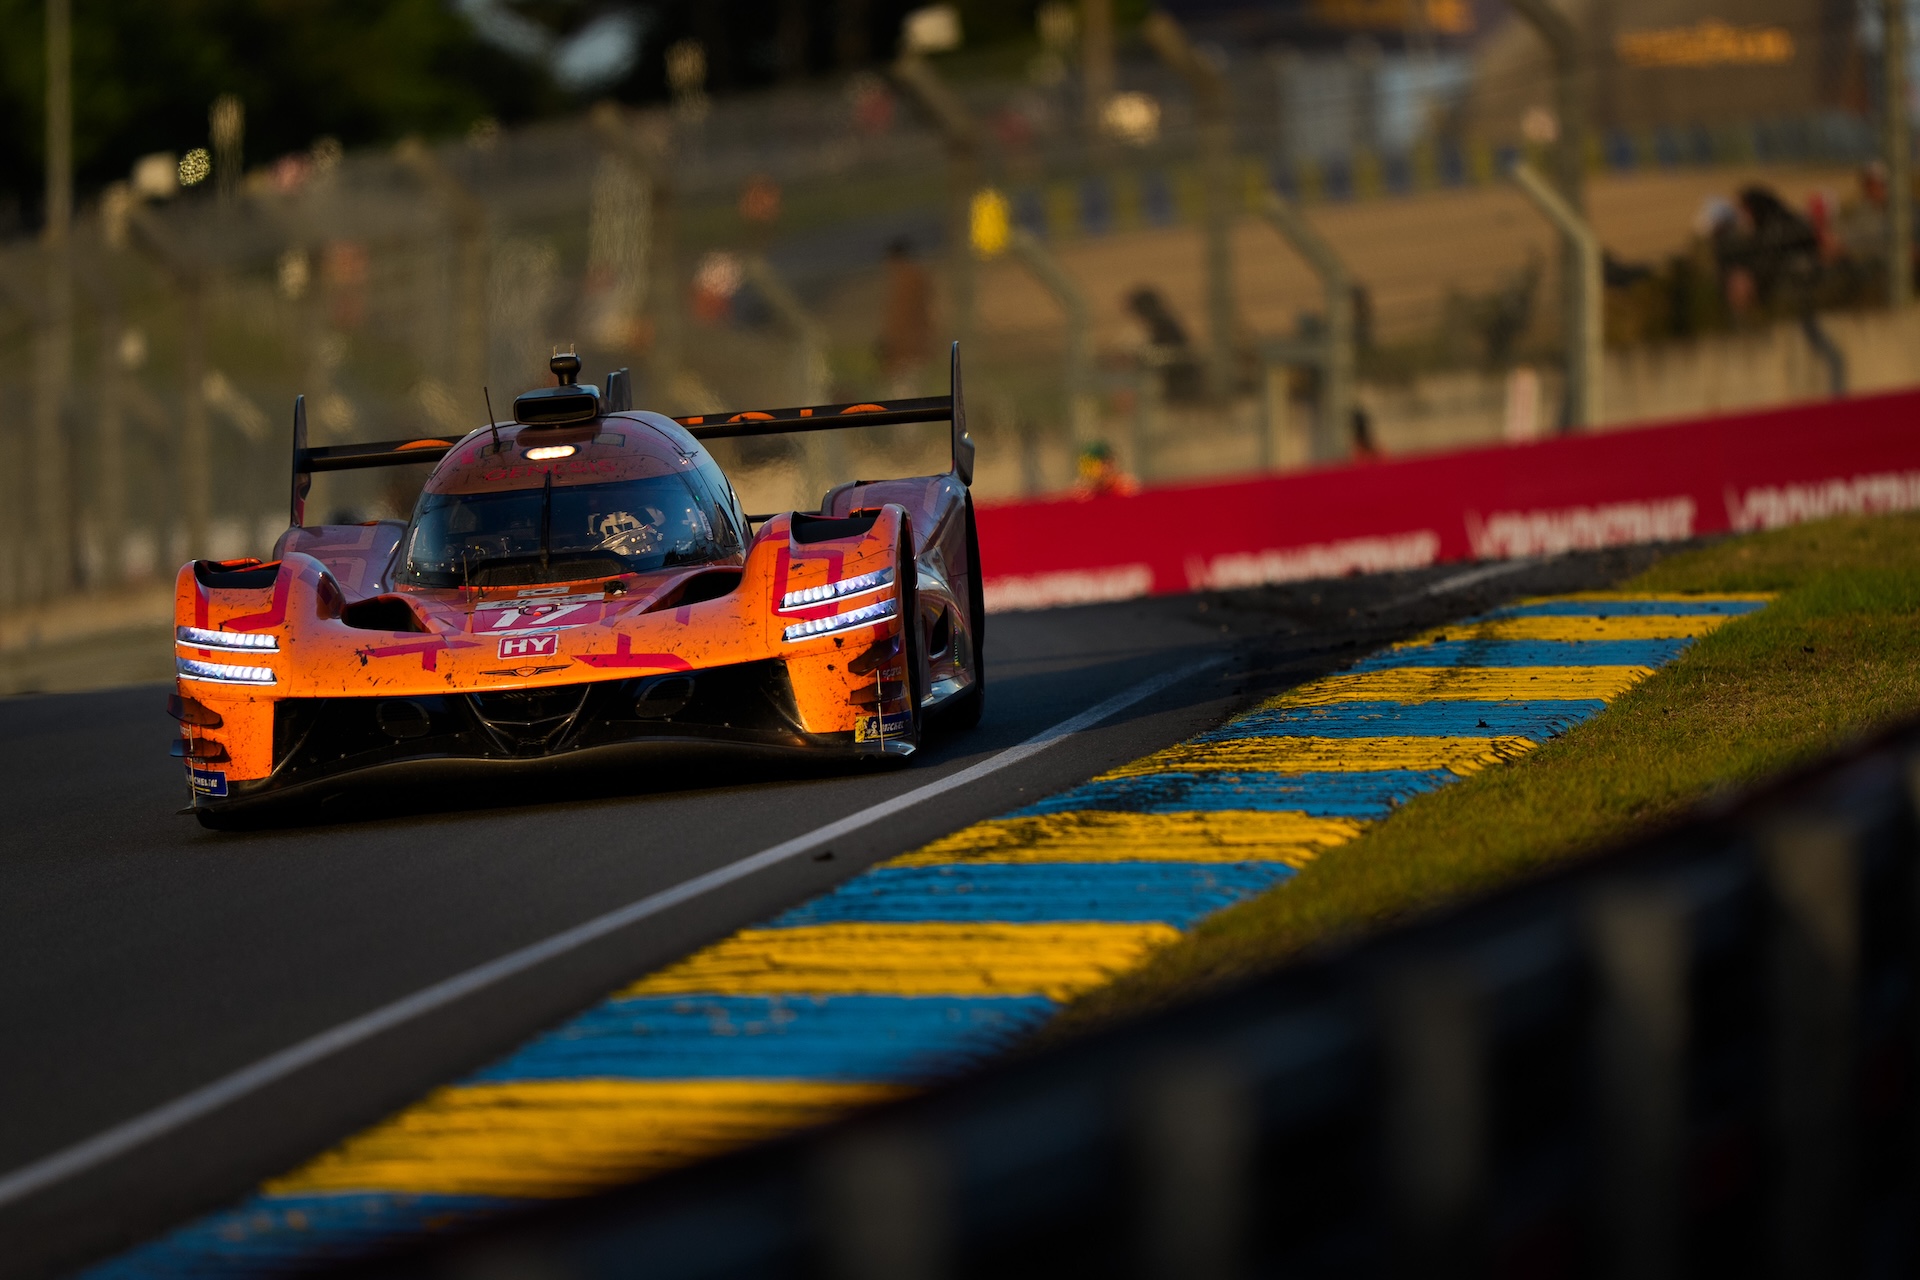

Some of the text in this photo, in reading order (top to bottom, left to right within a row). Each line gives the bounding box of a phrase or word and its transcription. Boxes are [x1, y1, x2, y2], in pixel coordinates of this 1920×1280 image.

[485, 460, 616, 481] GENESIS
[492, 603, 588, 628] 17
[503, 637, 553, 655] HY
[188, 775, 218, 788] MCHELIN
